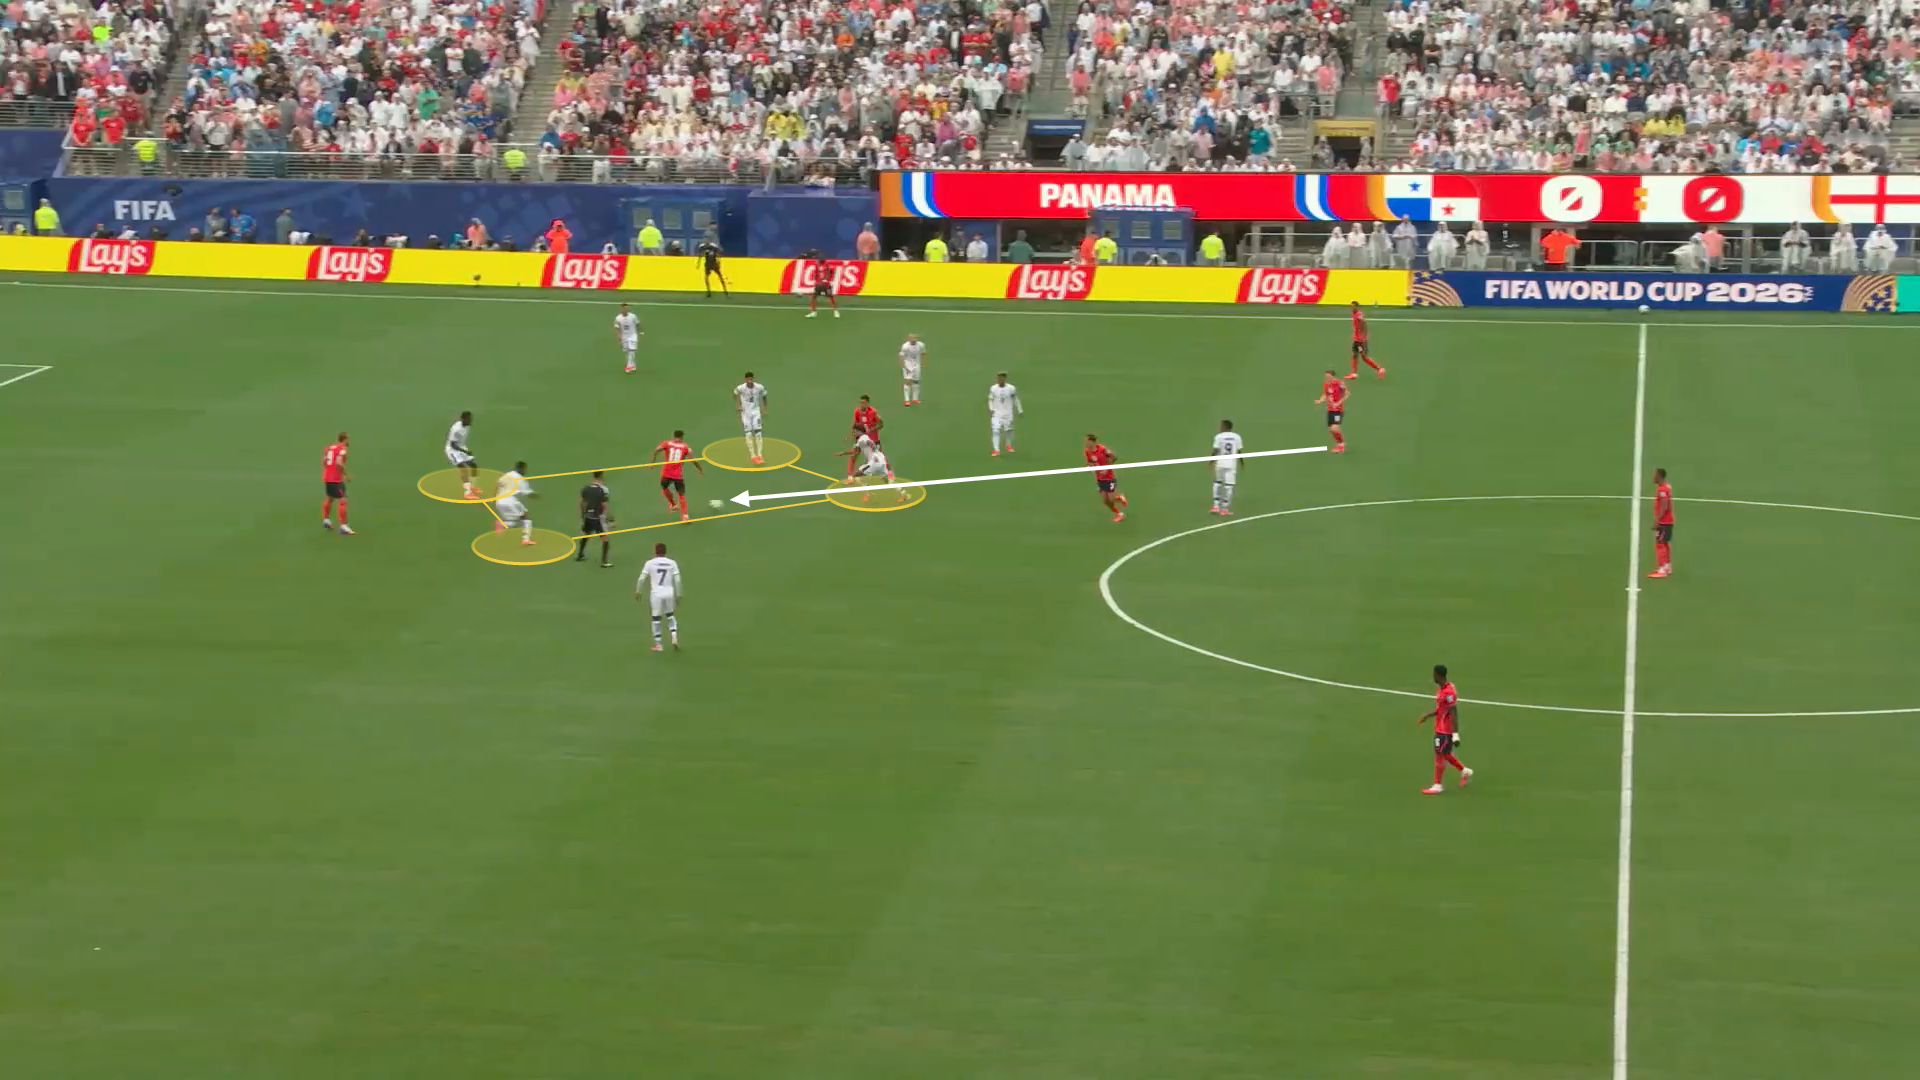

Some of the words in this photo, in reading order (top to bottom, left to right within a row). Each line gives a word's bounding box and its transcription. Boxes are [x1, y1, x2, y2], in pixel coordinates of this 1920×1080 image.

[114, 200, 176, 220] FIFA
[1040, 183, 1177, 208] PANAMA
[1540, 175, 1603, 222] 0
[1682, 176, 1744, 222] 0
[79, 238, 146, 274] Lay's
[316, 245, 384, 281] Lay's
[552, 252, 619, 289] Lay's
[1017, 264, 1087, 300] Lay's
[1249, 268, 1319, 304] Lay's
[1485, 280, 1543, 299] FIFA
[1545, 281, 1644, 300] WORLD
[1646, 281, 1703, 301] CUP
[657, 569, 668, 586] 7
